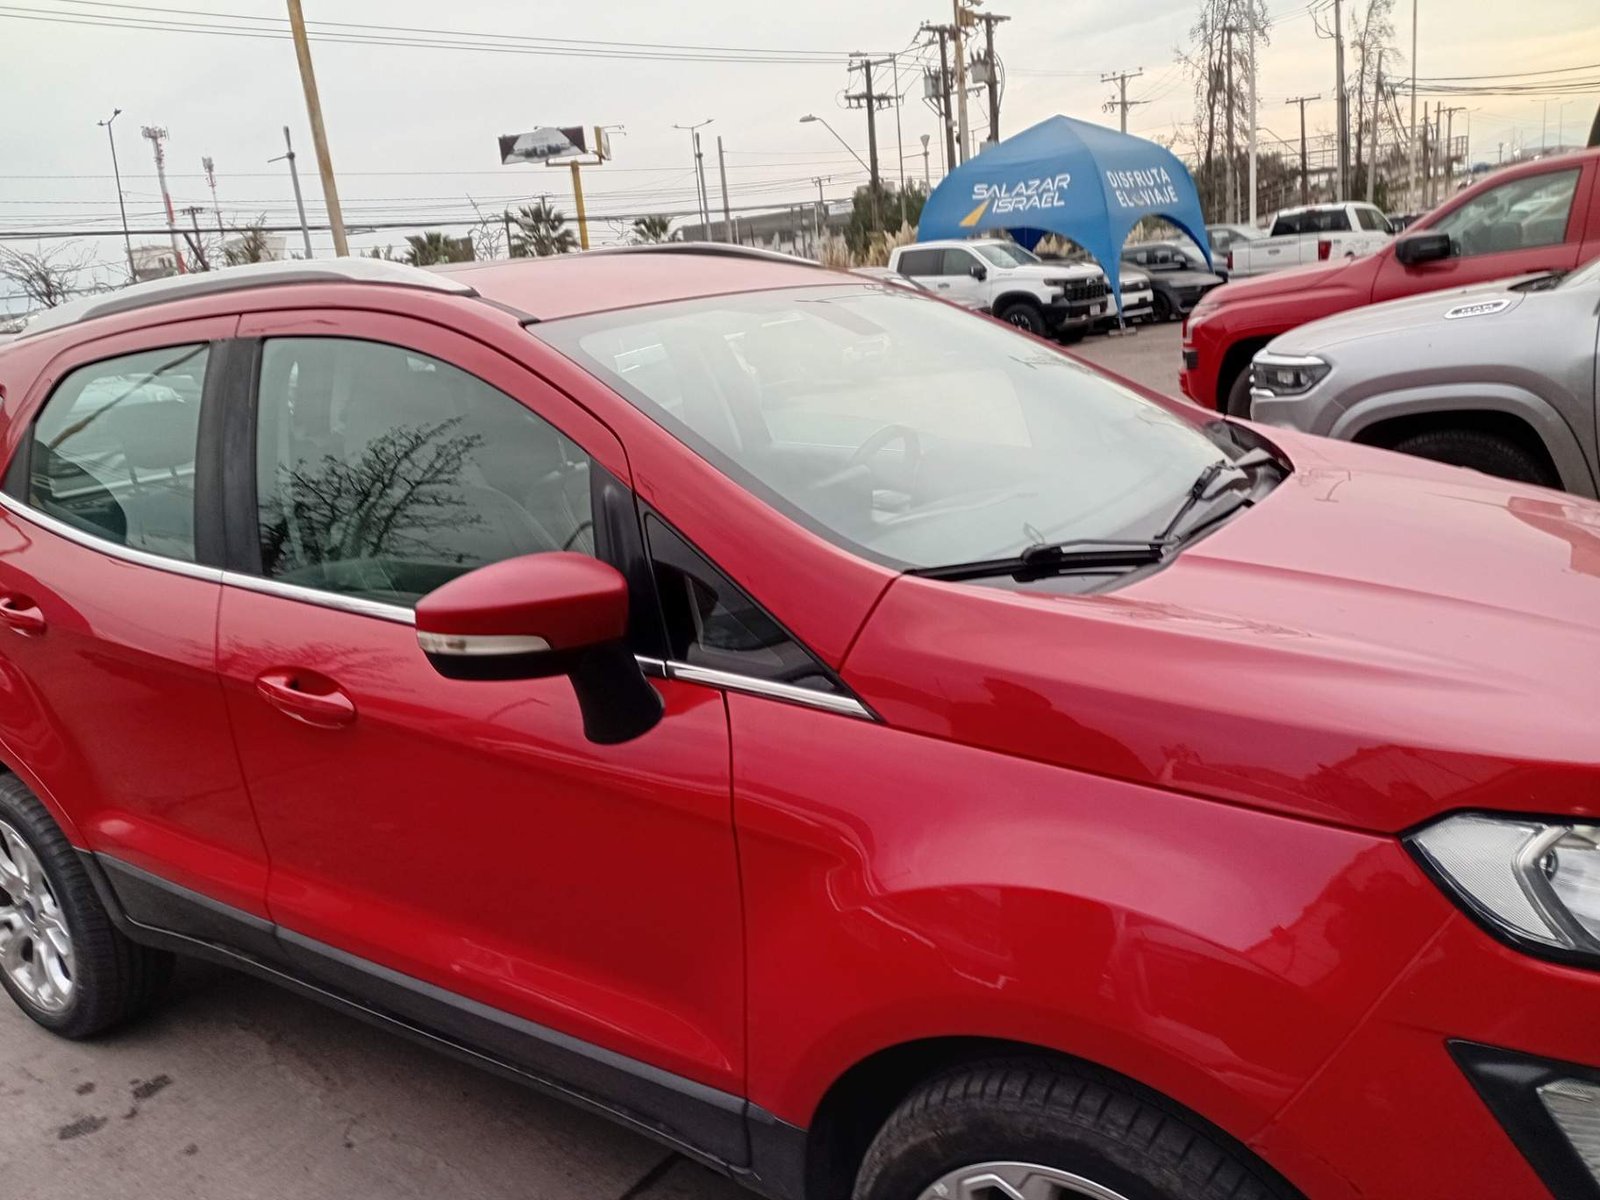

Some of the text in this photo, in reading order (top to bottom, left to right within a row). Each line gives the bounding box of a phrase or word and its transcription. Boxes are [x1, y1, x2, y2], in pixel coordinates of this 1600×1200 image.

[972, 173, 1071, 200] SALAZAR
[1106, 166, 1171, 188] DISFRUTA
[991, 191, 1066, 214] ISRAEL
[1115, 185, 1178, 207] EL VIAJE
